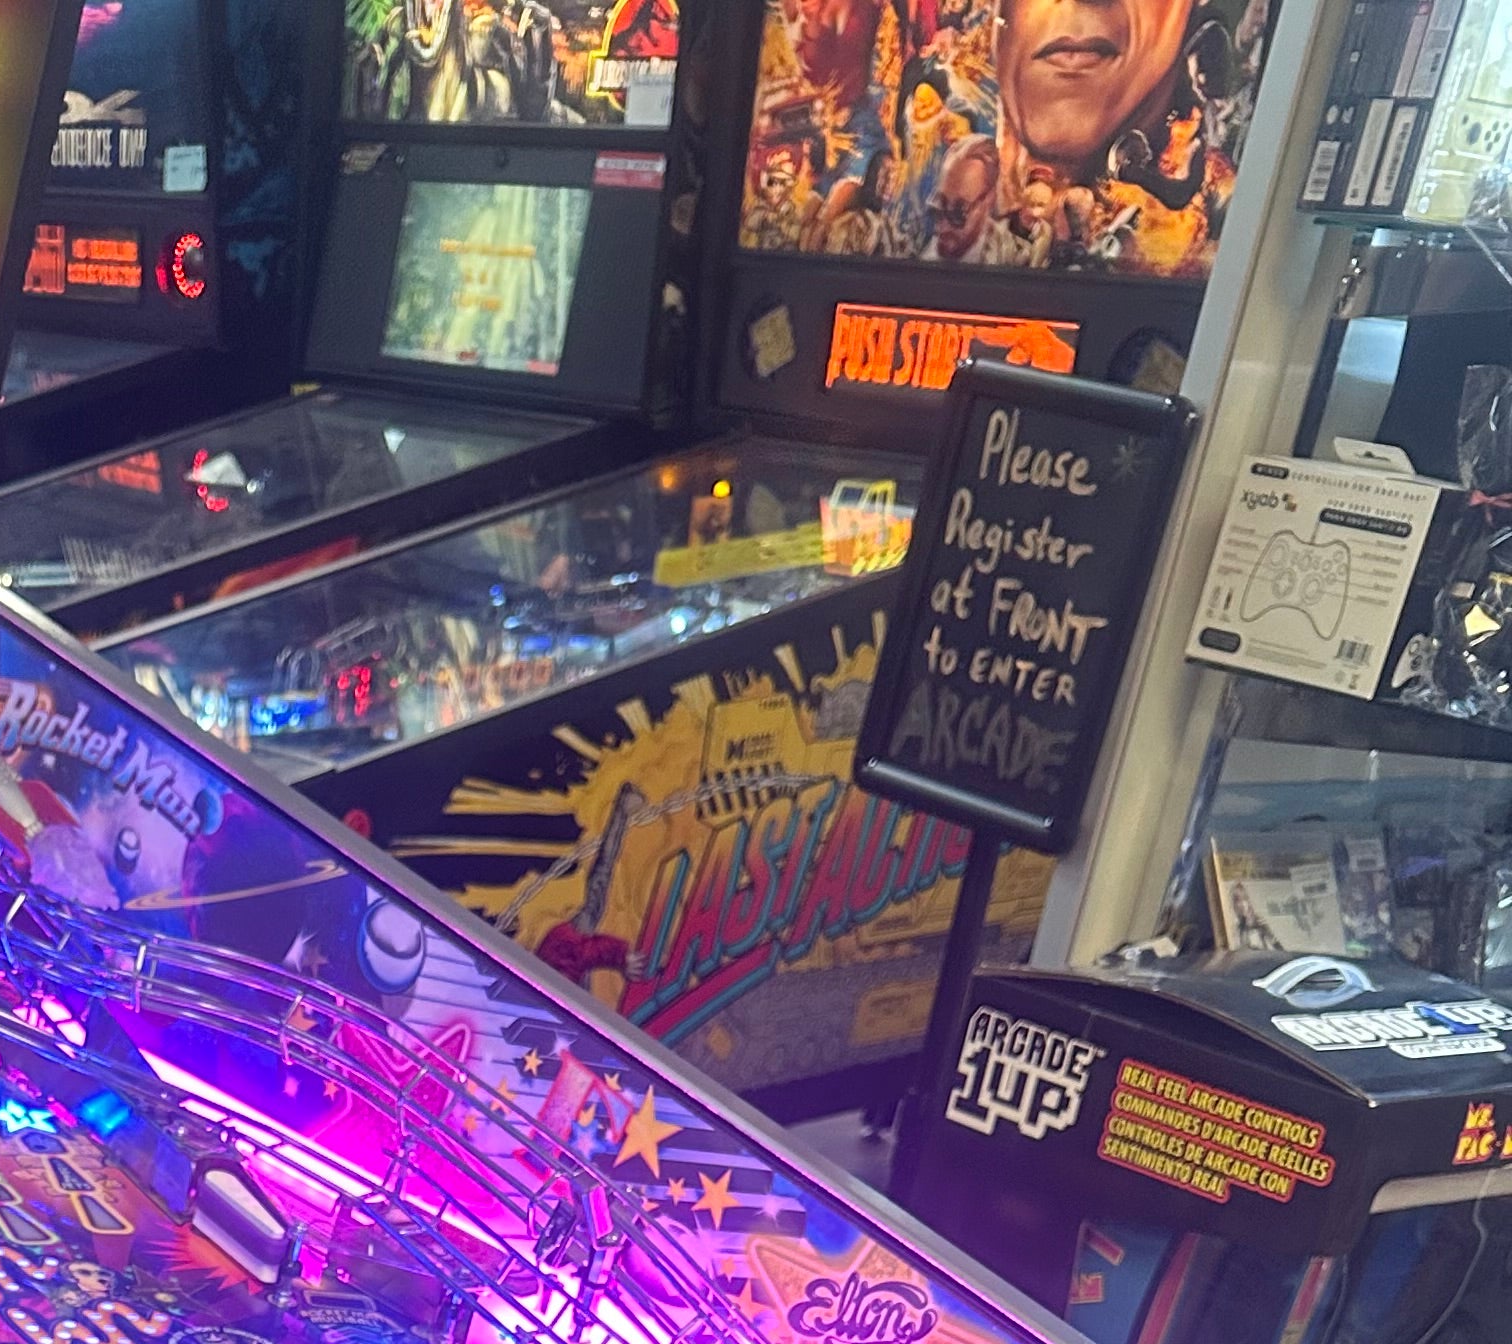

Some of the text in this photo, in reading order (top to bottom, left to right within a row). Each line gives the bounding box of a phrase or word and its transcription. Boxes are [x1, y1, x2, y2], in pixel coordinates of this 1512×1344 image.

[826, 313, 975, 389] PUSH START
[979, 407, 1097, 496] Please
[944, 487, 1093, 574] Register
[930, 564, 1109, 666] at FRONT
[923, 624, 1076, 707] to ENTER
[113, 739, 203, 838] Man
[967, 1007, 1093, 1088] ARCADE
[947, 1045, 1079, 1137] 1UP
[1121, 1065, 1320, 1149] REAL FEEL ARCADE CONTROLS
[1103, 1135, 1226, 1198] SENTIMIENTO REAL
[1108, 1115, 1290, 1196] CONTROLES DE ARCADE CON
[1114, 1091, 1331, 1182] COMMANDES D'ARCADE RÉELLES
[787, 1271, 939, 1344] Elton
